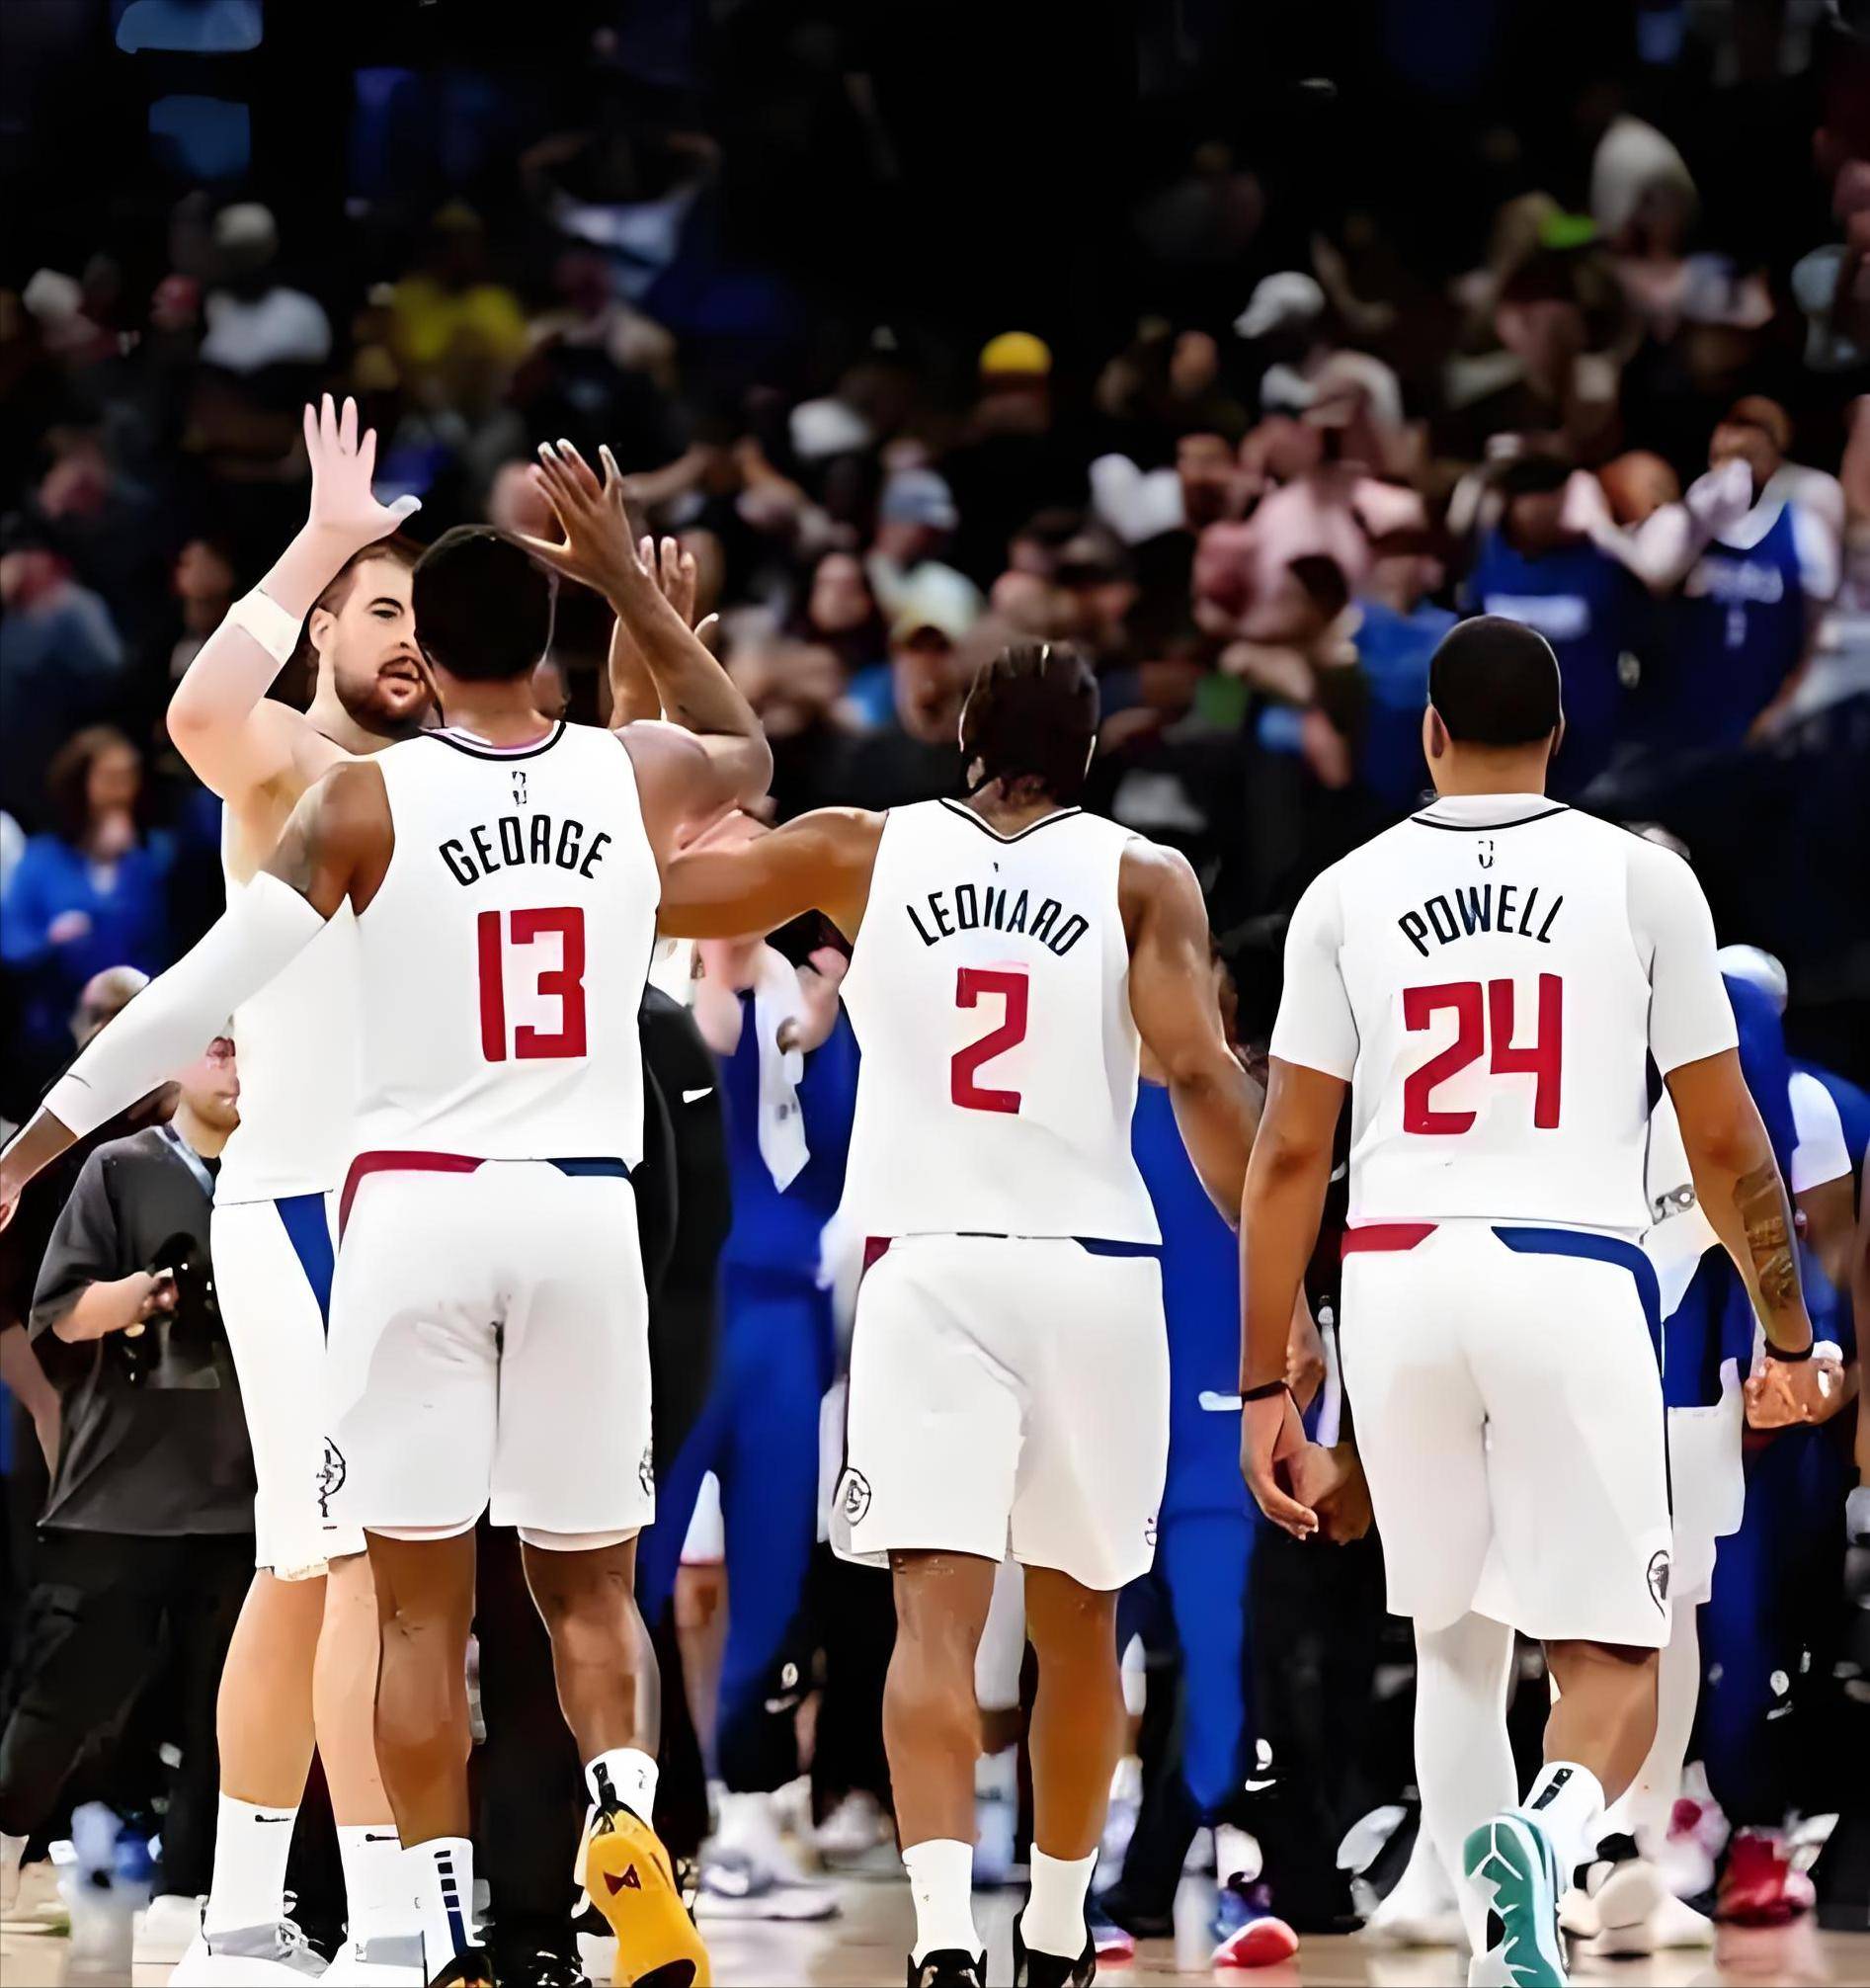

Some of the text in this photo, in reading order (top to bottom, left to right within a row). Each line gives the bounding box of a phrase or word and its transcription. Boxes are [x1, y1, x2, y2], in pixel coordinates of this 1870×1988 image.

[479, 908, 586, 1060] 13
[1399, 884, 1563, 956] POWELL
[951, 968, 1028, 1112] 2
[1404, 975, 1562, 1134] 24
